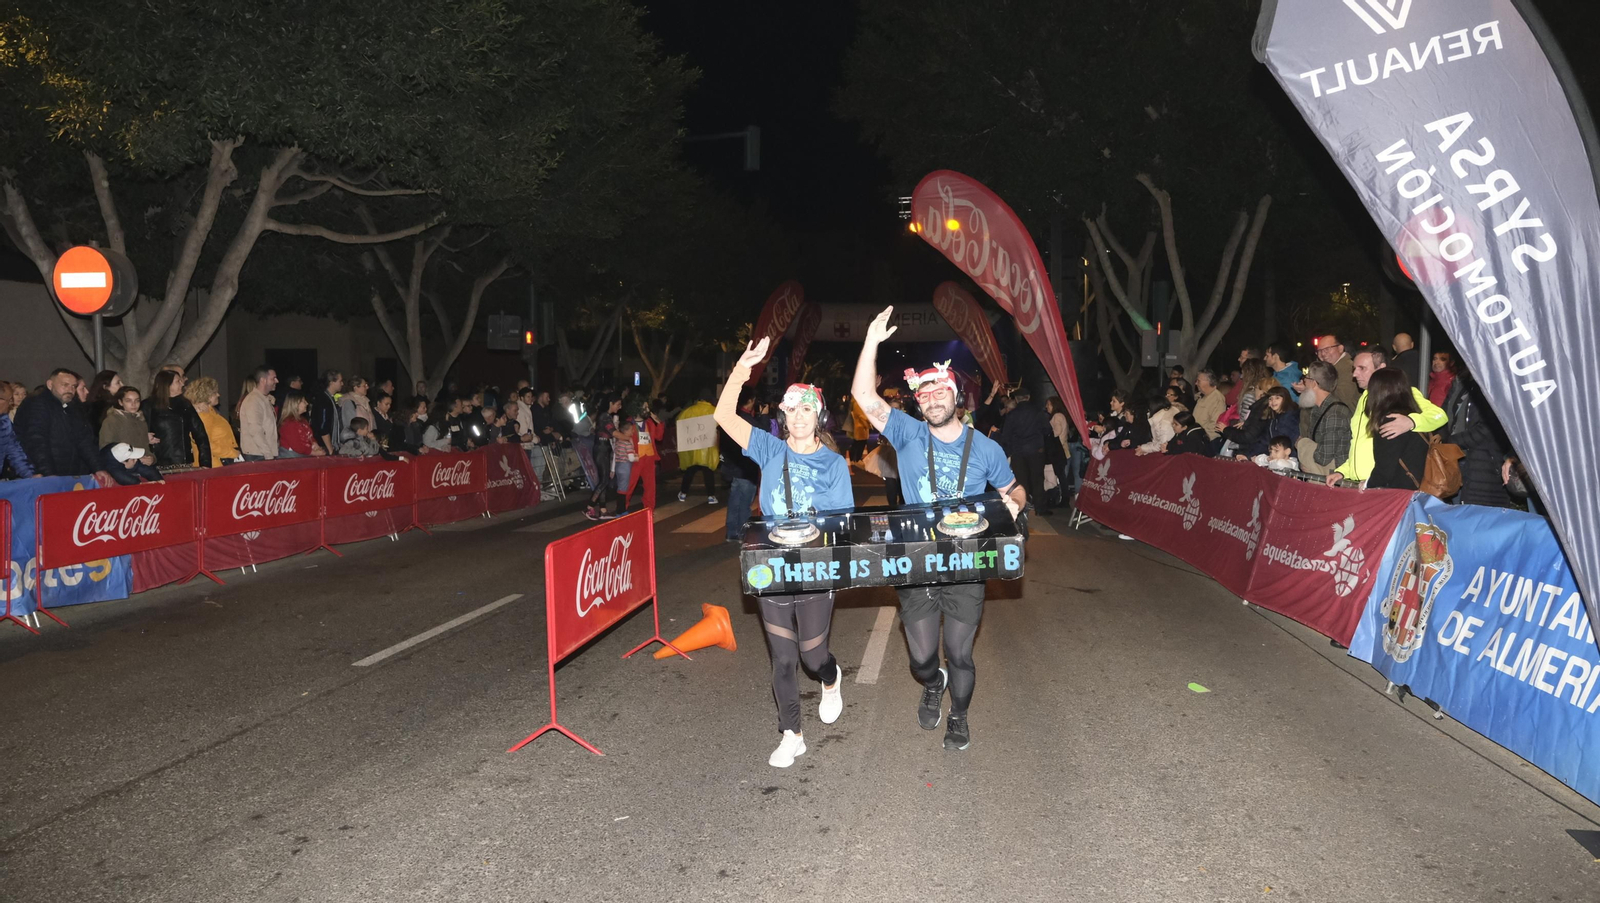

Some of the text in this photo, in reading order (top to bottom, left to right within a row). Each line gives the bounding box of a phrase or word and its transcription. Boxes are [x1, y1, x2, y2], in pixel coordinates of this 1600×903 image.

[866, 309, 938, 327] AMERÍA
[344, 469, 395, 503] Coca-Cola
[432, 460, 471, 488] Coca-Cola
[232, 479, 299, 519] Coca-Cola
[72, 494, 164, 546] Coca-Cola
[576, 532, 633, 617] Coca-Cola
[769, 544, 1020, 582] THERE IS NO PLANET B
[1437, 610, 1485, 656] DE
